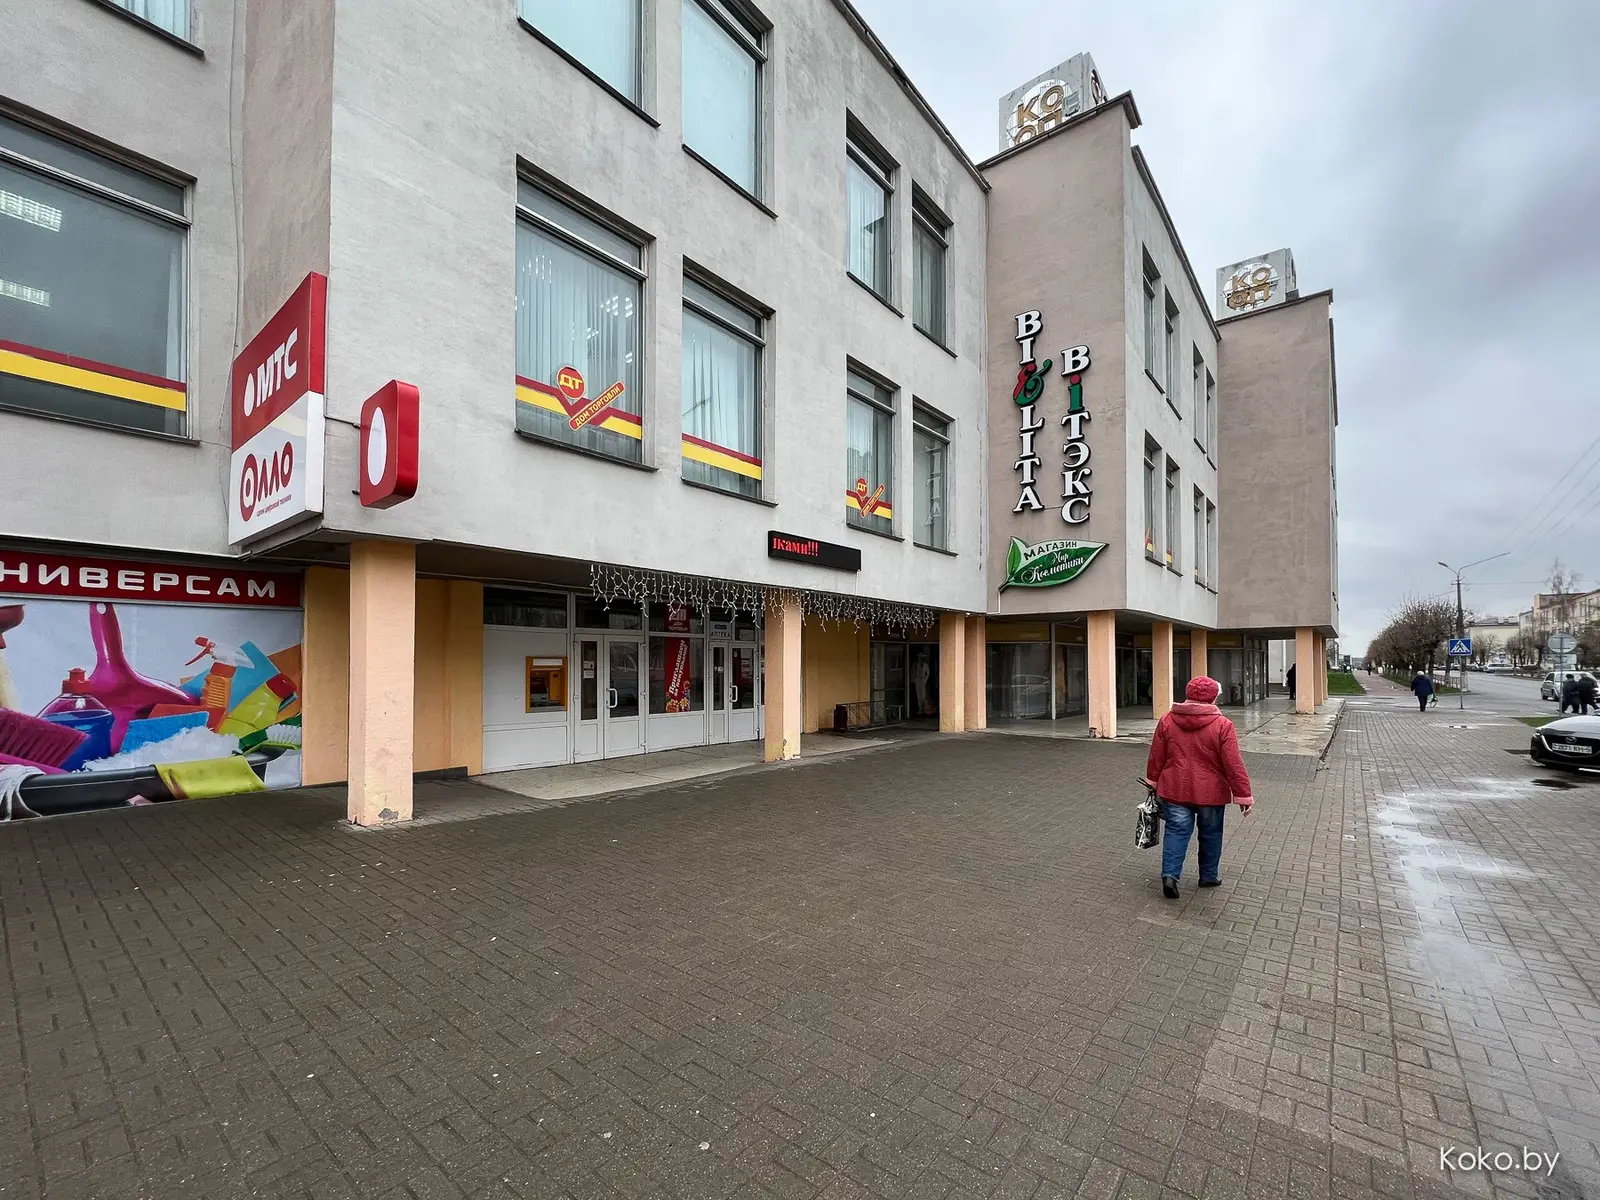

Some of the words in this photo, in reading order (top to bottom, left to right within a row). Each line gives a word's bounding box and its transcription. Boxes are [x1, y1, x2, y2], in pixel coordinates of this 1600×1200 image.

[256, 327, 298, 408] МТС
[575, 411, 591, 427] ДОМ
[590, 385, 620, 414] ТОРГОВЛИ
[1023, 541, 1077, 561] МАГАЗИН
[1045, 550, 1070, 573] Мир
[0, 560, 275, 598] НИВЕРСАМ
[1021, 556, 1084, 584] Косметики
